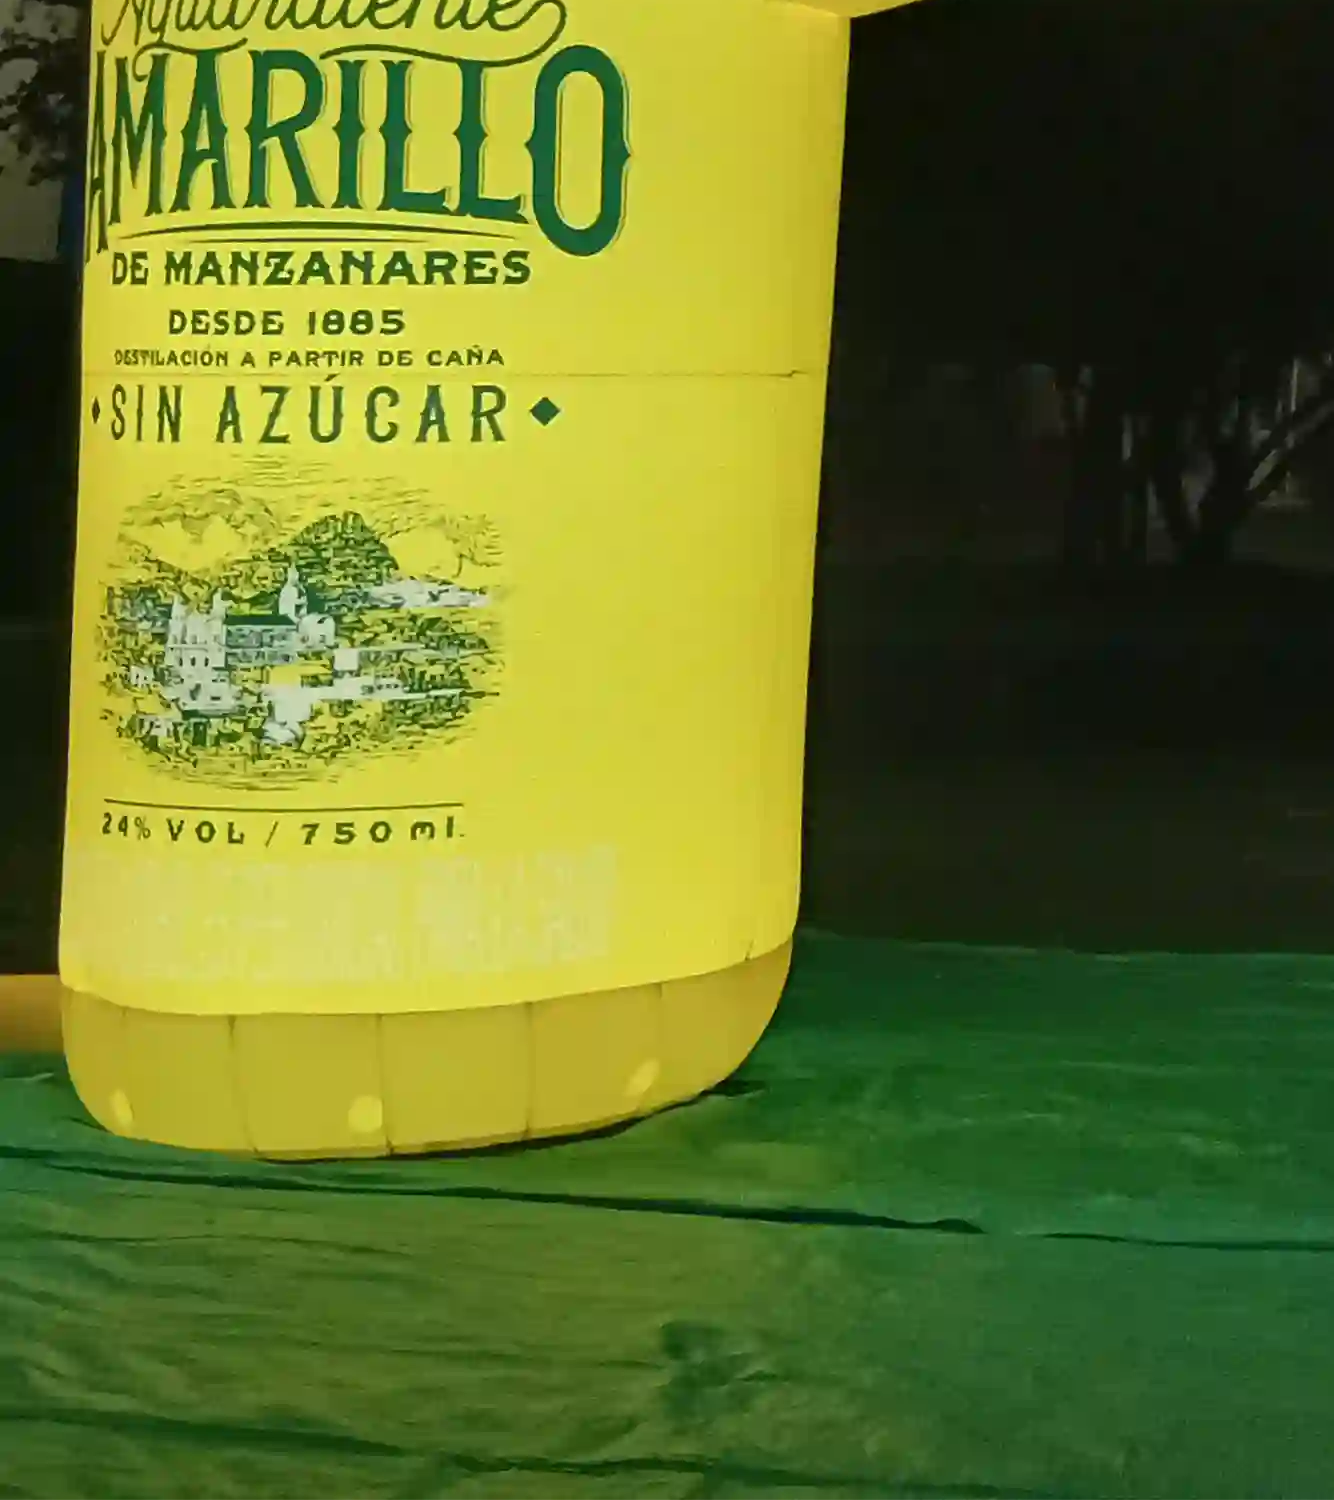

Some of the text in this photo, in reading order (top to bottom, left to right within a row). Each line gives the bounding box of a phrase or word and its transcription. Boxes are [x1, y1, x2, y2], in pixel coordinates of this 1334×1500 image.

[112, 250, 531, 286] DE MANZANARES
[168, 309, 406, 336] DESDE 1885
[113, 344, 506, 368] DESTILACIÓN A PARTIR DE CAÑA
[110, 373, 508, 444] SIN AZÚCAR
[101, 812, 152, 841] 24%
[166, 821, 246, 846] VOL
[300, 821, 392, 847] 750
